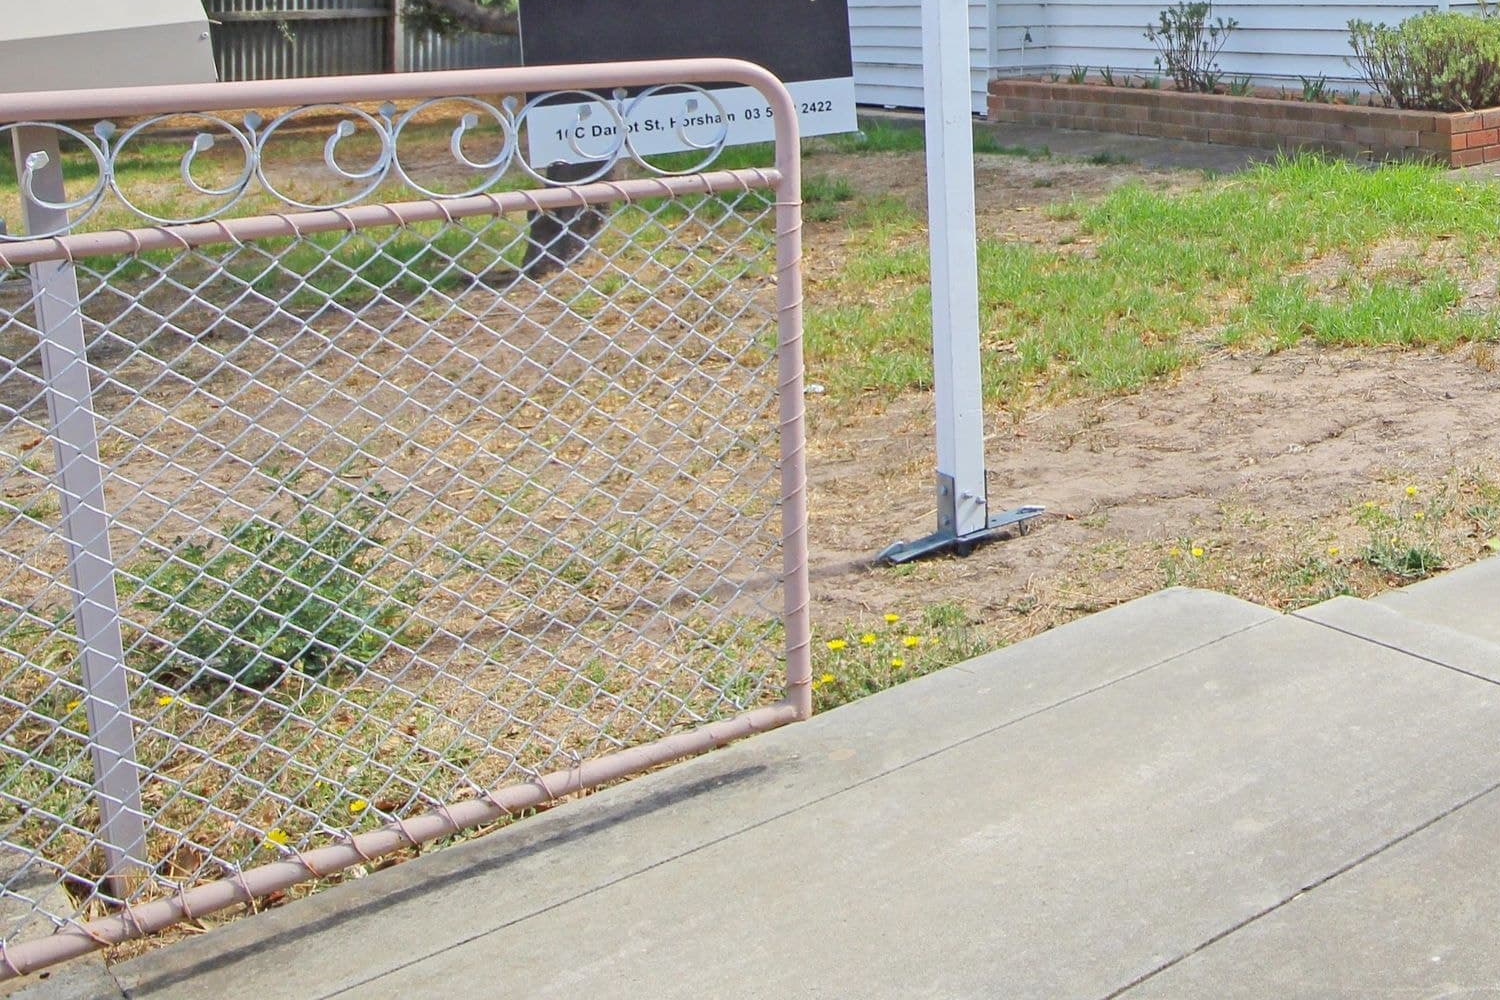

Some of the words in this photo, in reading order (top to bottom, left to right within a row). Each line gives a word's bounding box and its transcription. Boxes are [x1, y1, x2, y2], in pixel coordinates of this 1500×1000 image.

[644, 119, 664, 132] St,
[745, 108, 761, 120] 03
[801, 100, 832, 114] 2422
